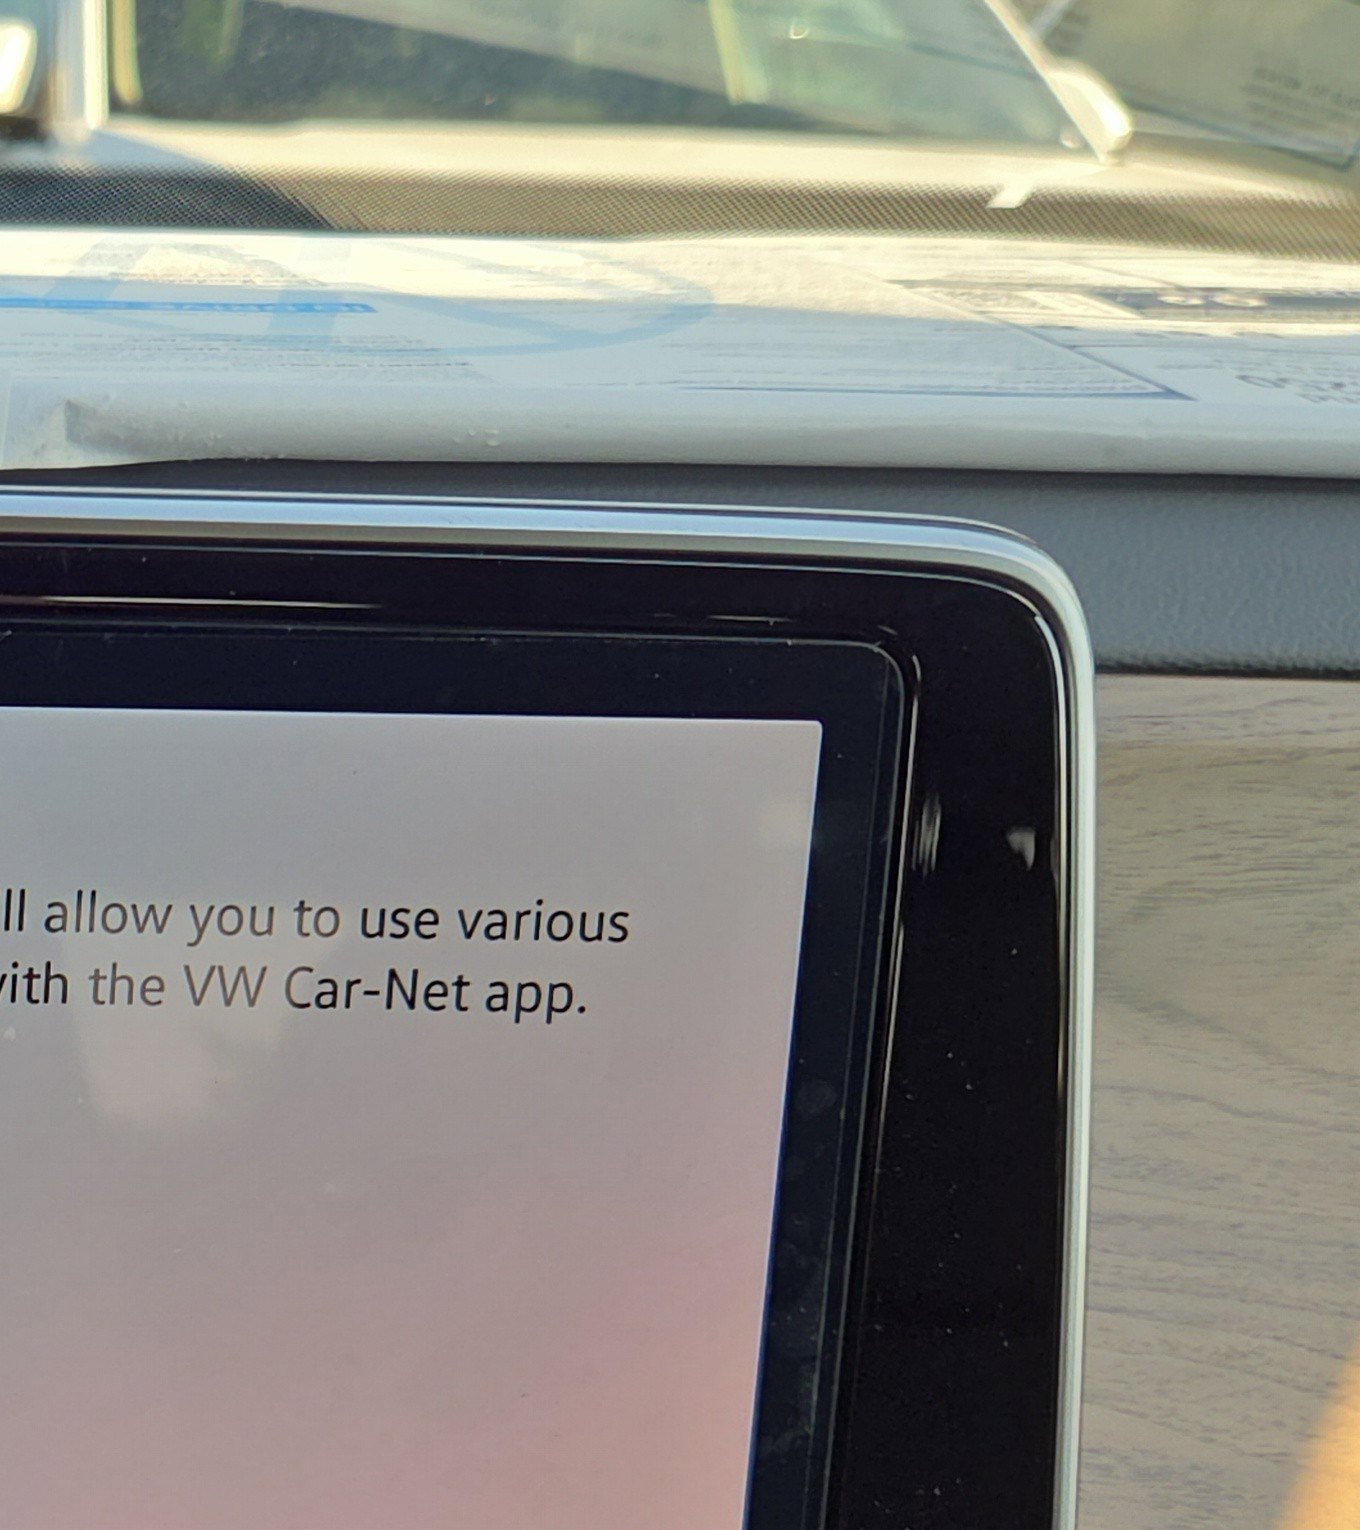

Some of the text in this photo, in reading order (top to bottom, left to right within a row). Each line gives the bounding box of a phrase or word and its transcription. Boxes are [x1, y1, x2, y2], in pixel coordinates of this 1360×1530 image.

[44, 889, 172, 933] allow
[187, 905, 274, 947] you
[294, 900, 341, 937] to
[360, 908, 439, 939] use
[458, 899, 629, 943] various
[88, 962, 165, 1006] the
[184, 965, 267, 1007] VW
[285, 966, 470, 1013] Car-Net
[486, 981, 586, 1024] app.
